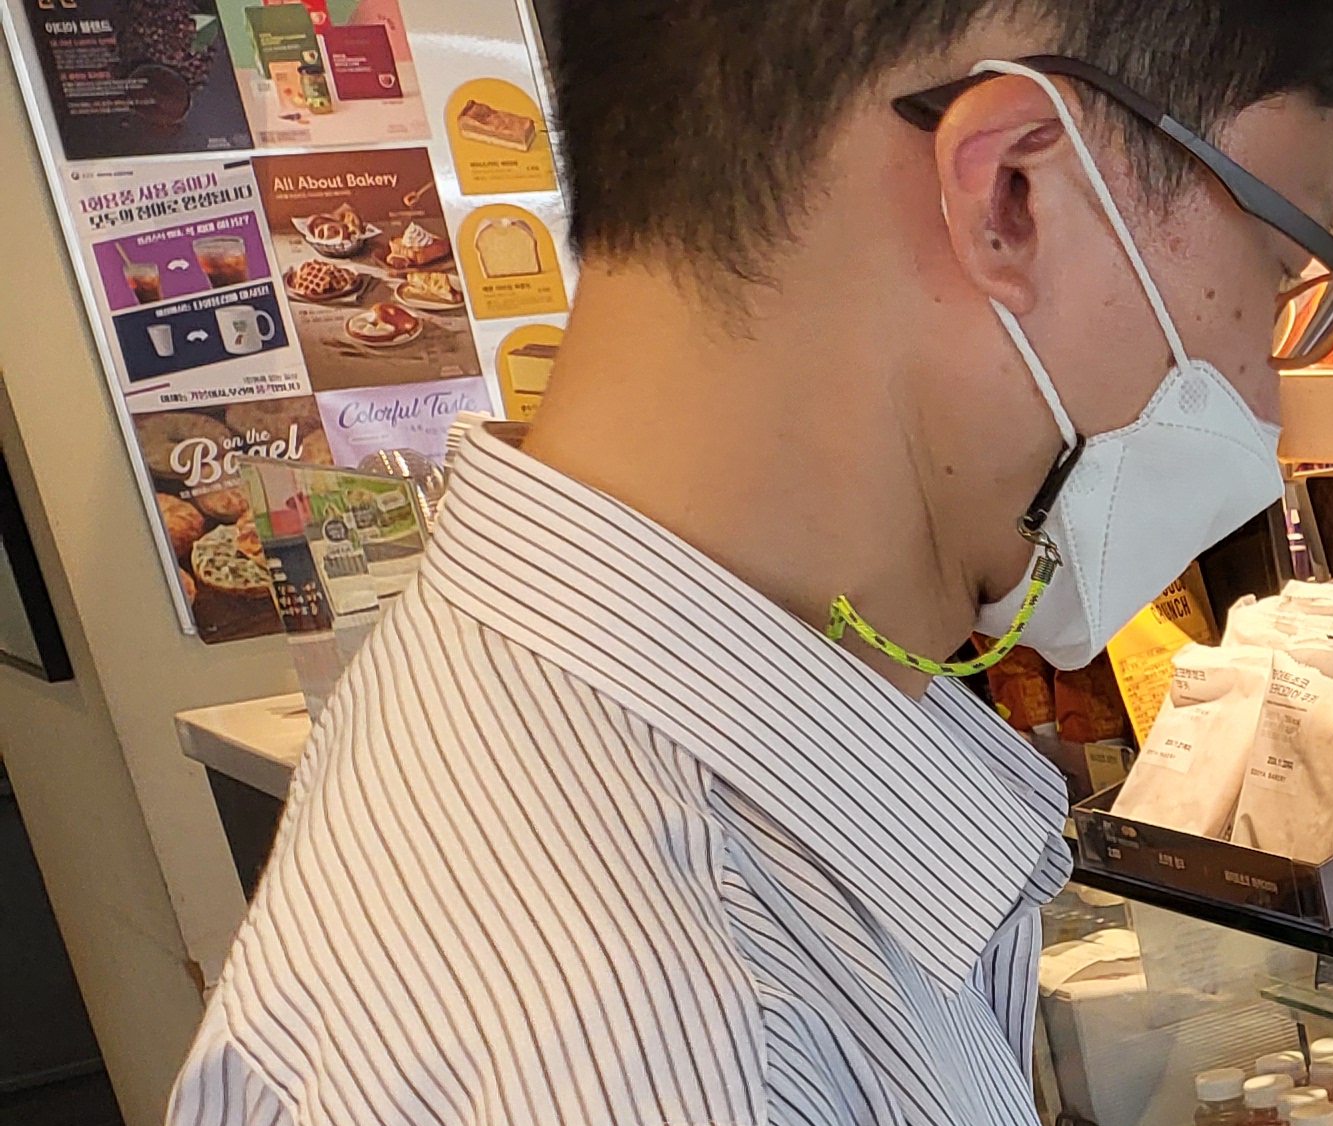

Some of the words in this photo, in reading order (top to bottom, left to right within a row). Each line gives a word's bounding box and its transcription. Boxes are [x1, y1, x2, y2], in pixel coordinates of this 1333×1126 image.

[273, 175, 293, 191] All
[298, 175, 342, 189] About
[347, 172, 397, 187] Bakery
[339, 398, 420, 429] Colorful
[222, 435, 242, 448] on
[245, 429, 270, 444] the
